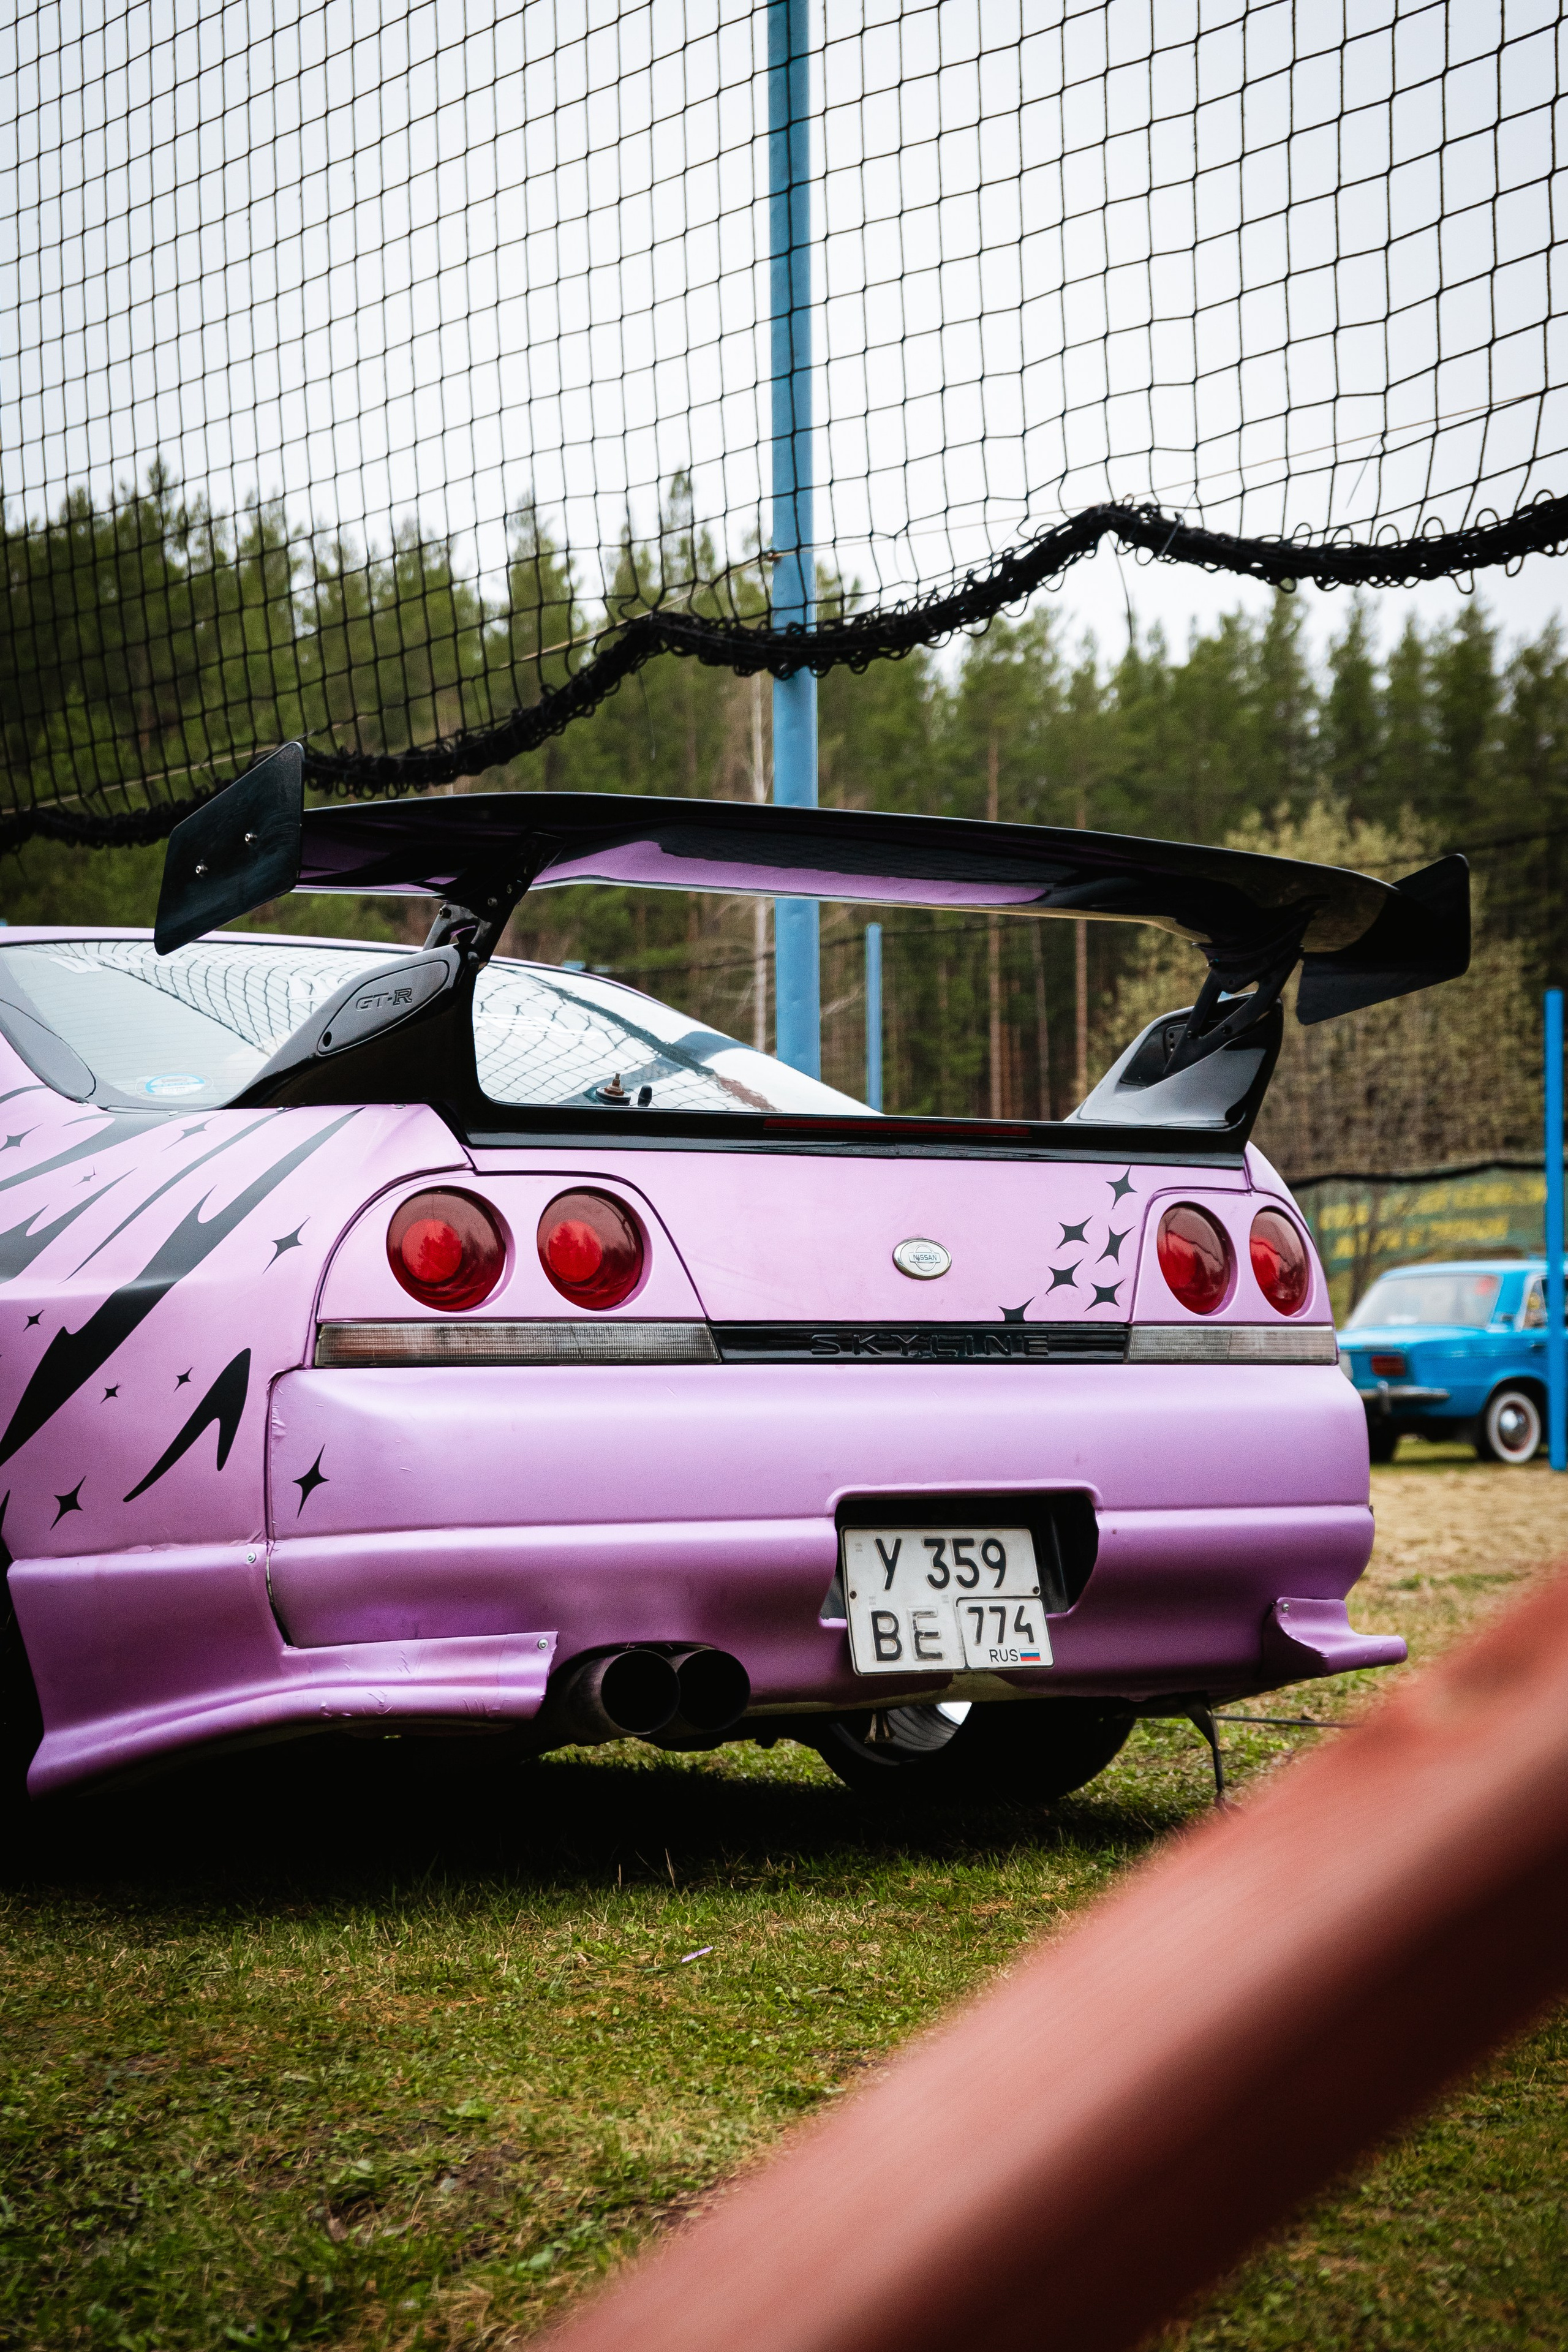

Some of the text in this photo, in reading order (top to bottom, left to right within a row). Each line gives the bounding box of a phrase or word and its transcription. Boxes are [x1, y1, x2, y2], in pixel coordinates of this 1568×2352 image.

[356, 988, 413, 1011] GT-R
[811, 1333, 1049, 1357] SKYLINE
[923, 1537, 1006, 1589] 359
[967, 1605, 1035, 1645] 774
[989, 1648, 1019, 1663] RUS
